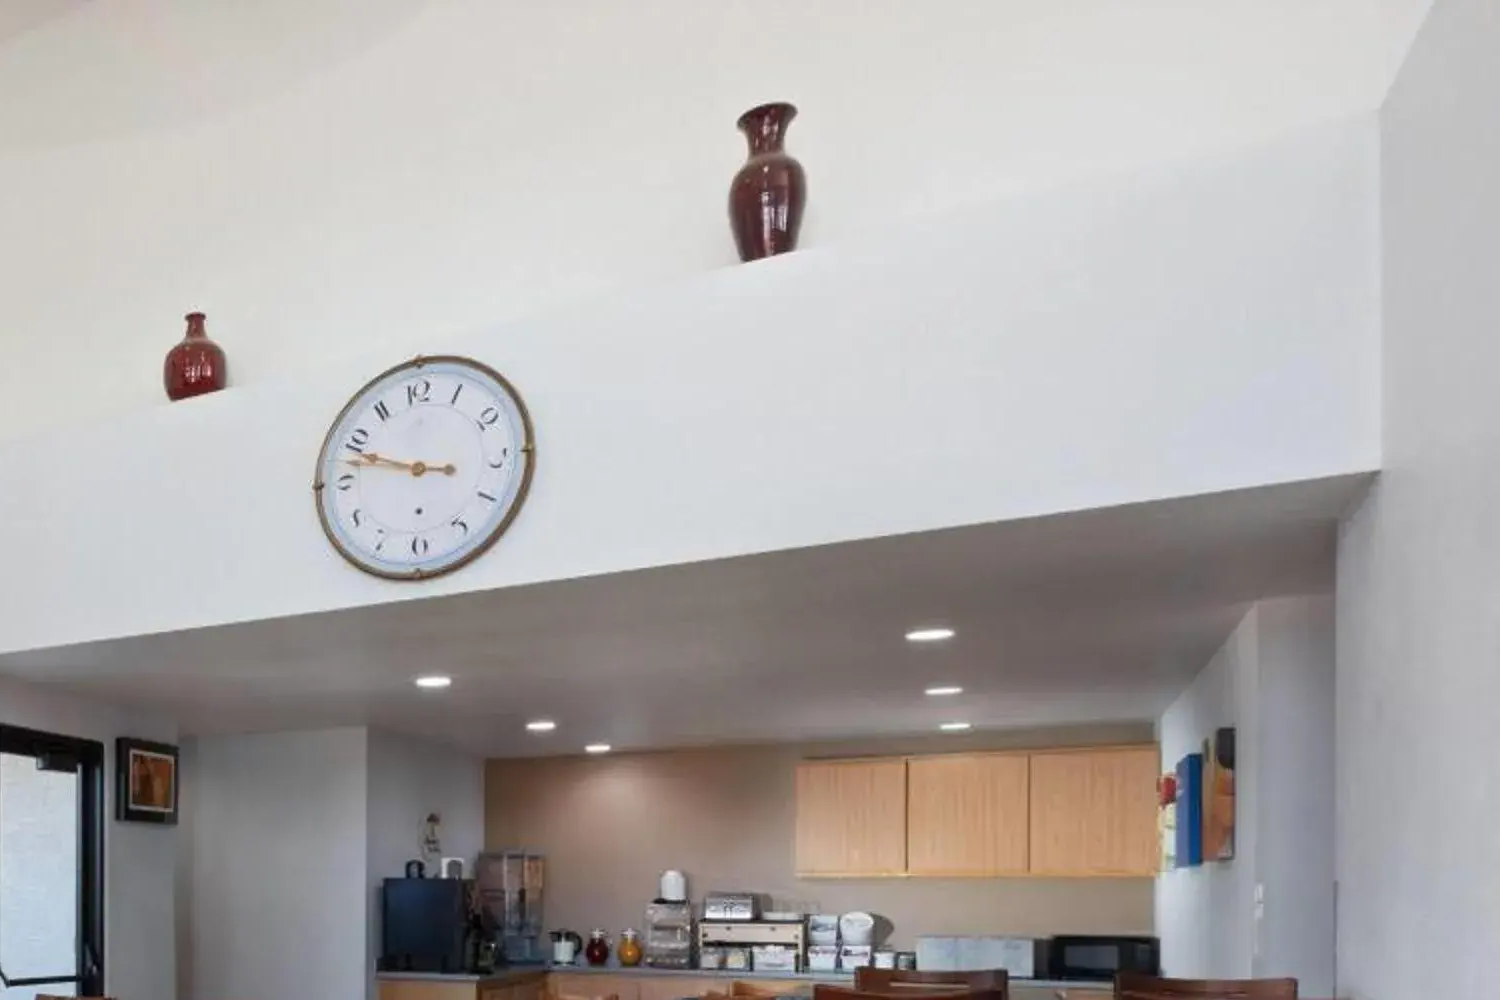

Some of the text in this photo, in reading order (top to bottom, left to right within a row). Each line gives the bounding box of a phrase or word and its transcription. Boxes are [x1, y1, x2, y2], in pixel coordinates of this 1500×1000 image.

[406, 380, 431, 407] 12
[451, 383, 463, 405] 1
[345, 428, 369, 453] 10
